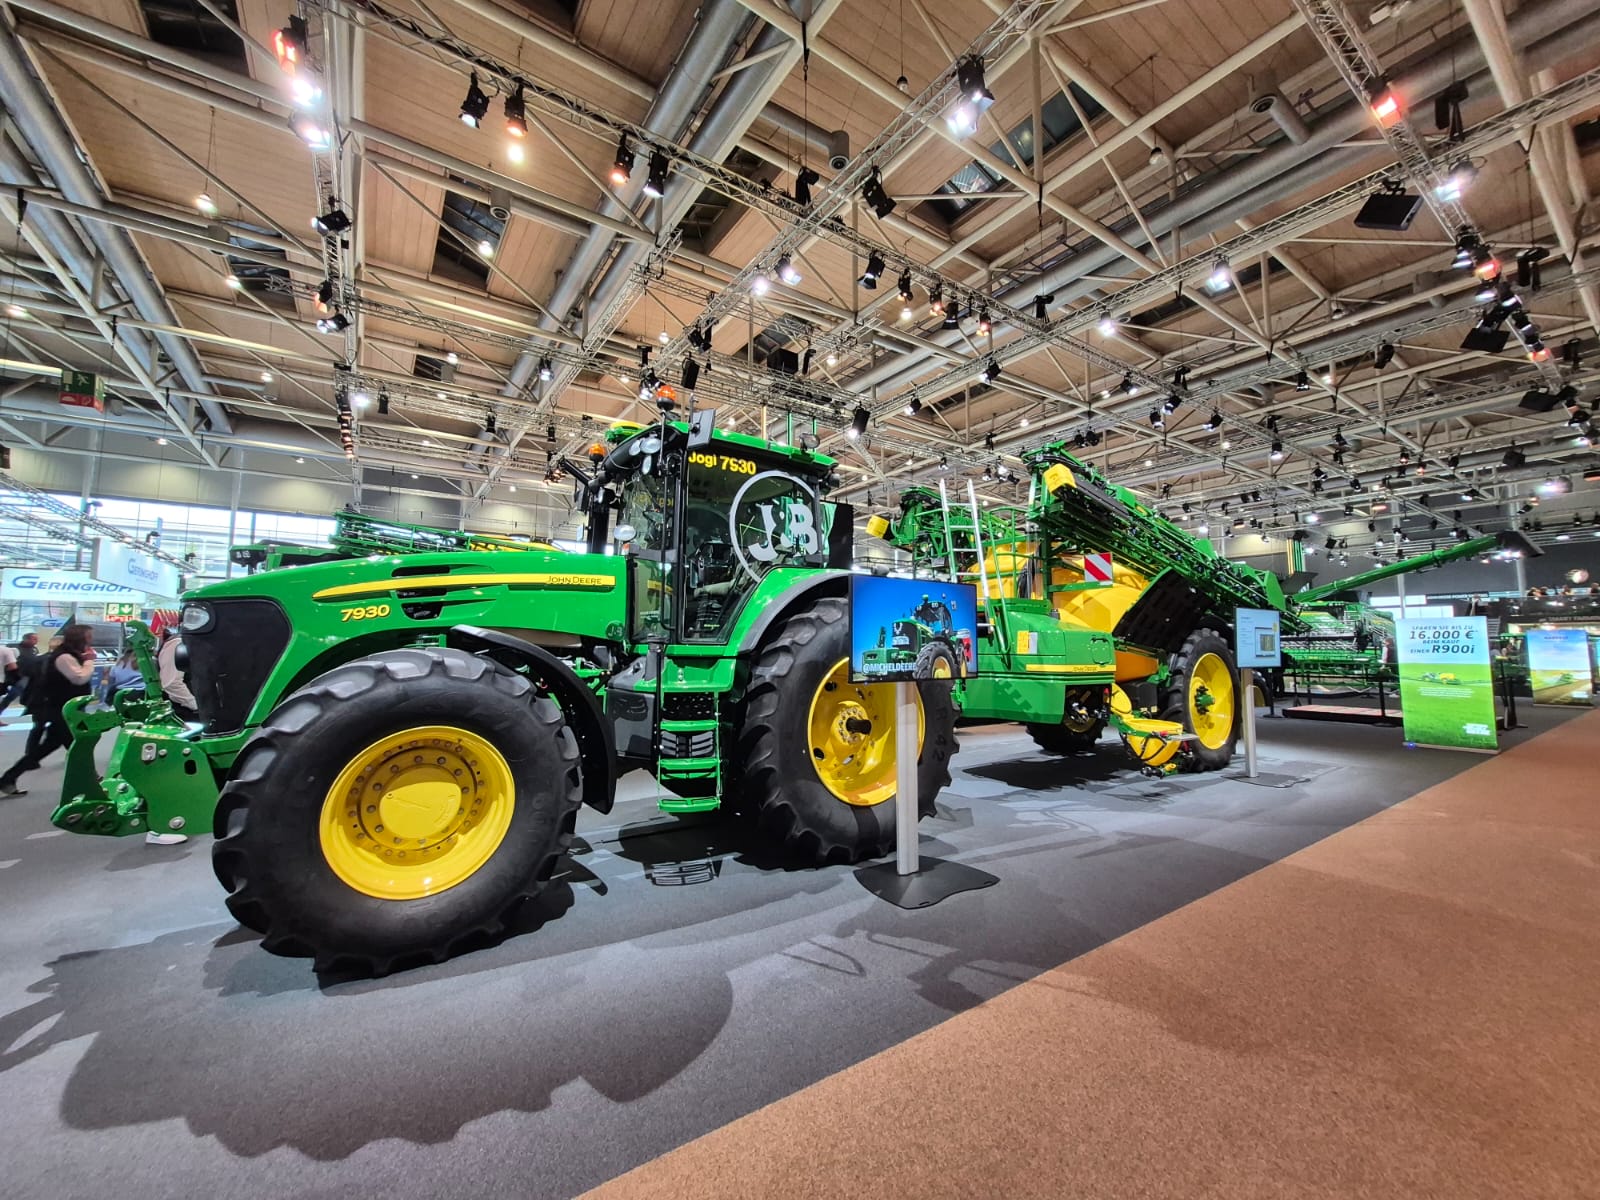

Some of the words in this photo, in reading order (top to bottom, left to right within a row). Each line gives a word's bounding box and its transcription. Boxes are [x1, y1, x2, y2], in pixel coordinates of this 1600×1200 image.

[688, 451, 717, 468] Jogi
[547, 575, 571, 584] JOHN
[572, 576, 602, 585] DEERE
[340, 604, 391, 622] 7930
[1409, 630, 1461, 640] 16.000
[1432, 645, 1475, 654] R900i
